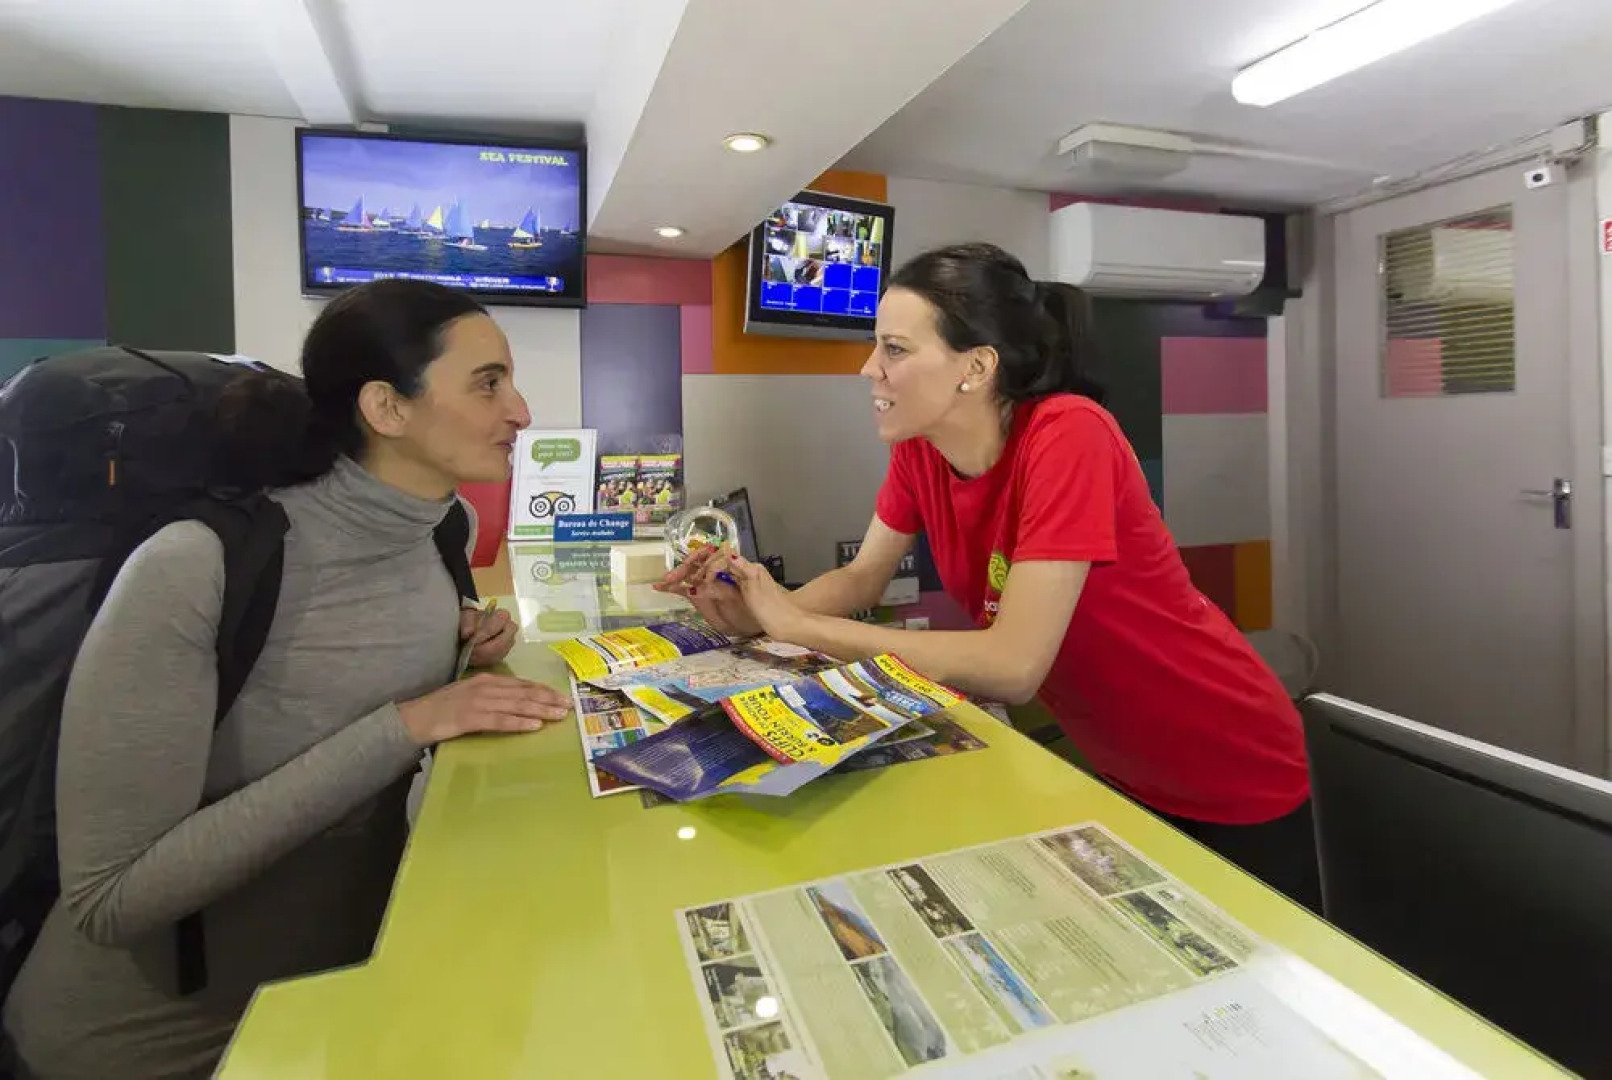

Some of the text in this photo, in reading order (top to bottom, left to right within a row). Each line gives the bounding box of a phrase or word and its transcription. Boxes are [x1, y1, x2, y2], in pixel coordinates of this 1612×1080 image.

[479, 152, 569, 166] SEA FESTIVAL
[558, 519, 629, 529] Bureau de Change
